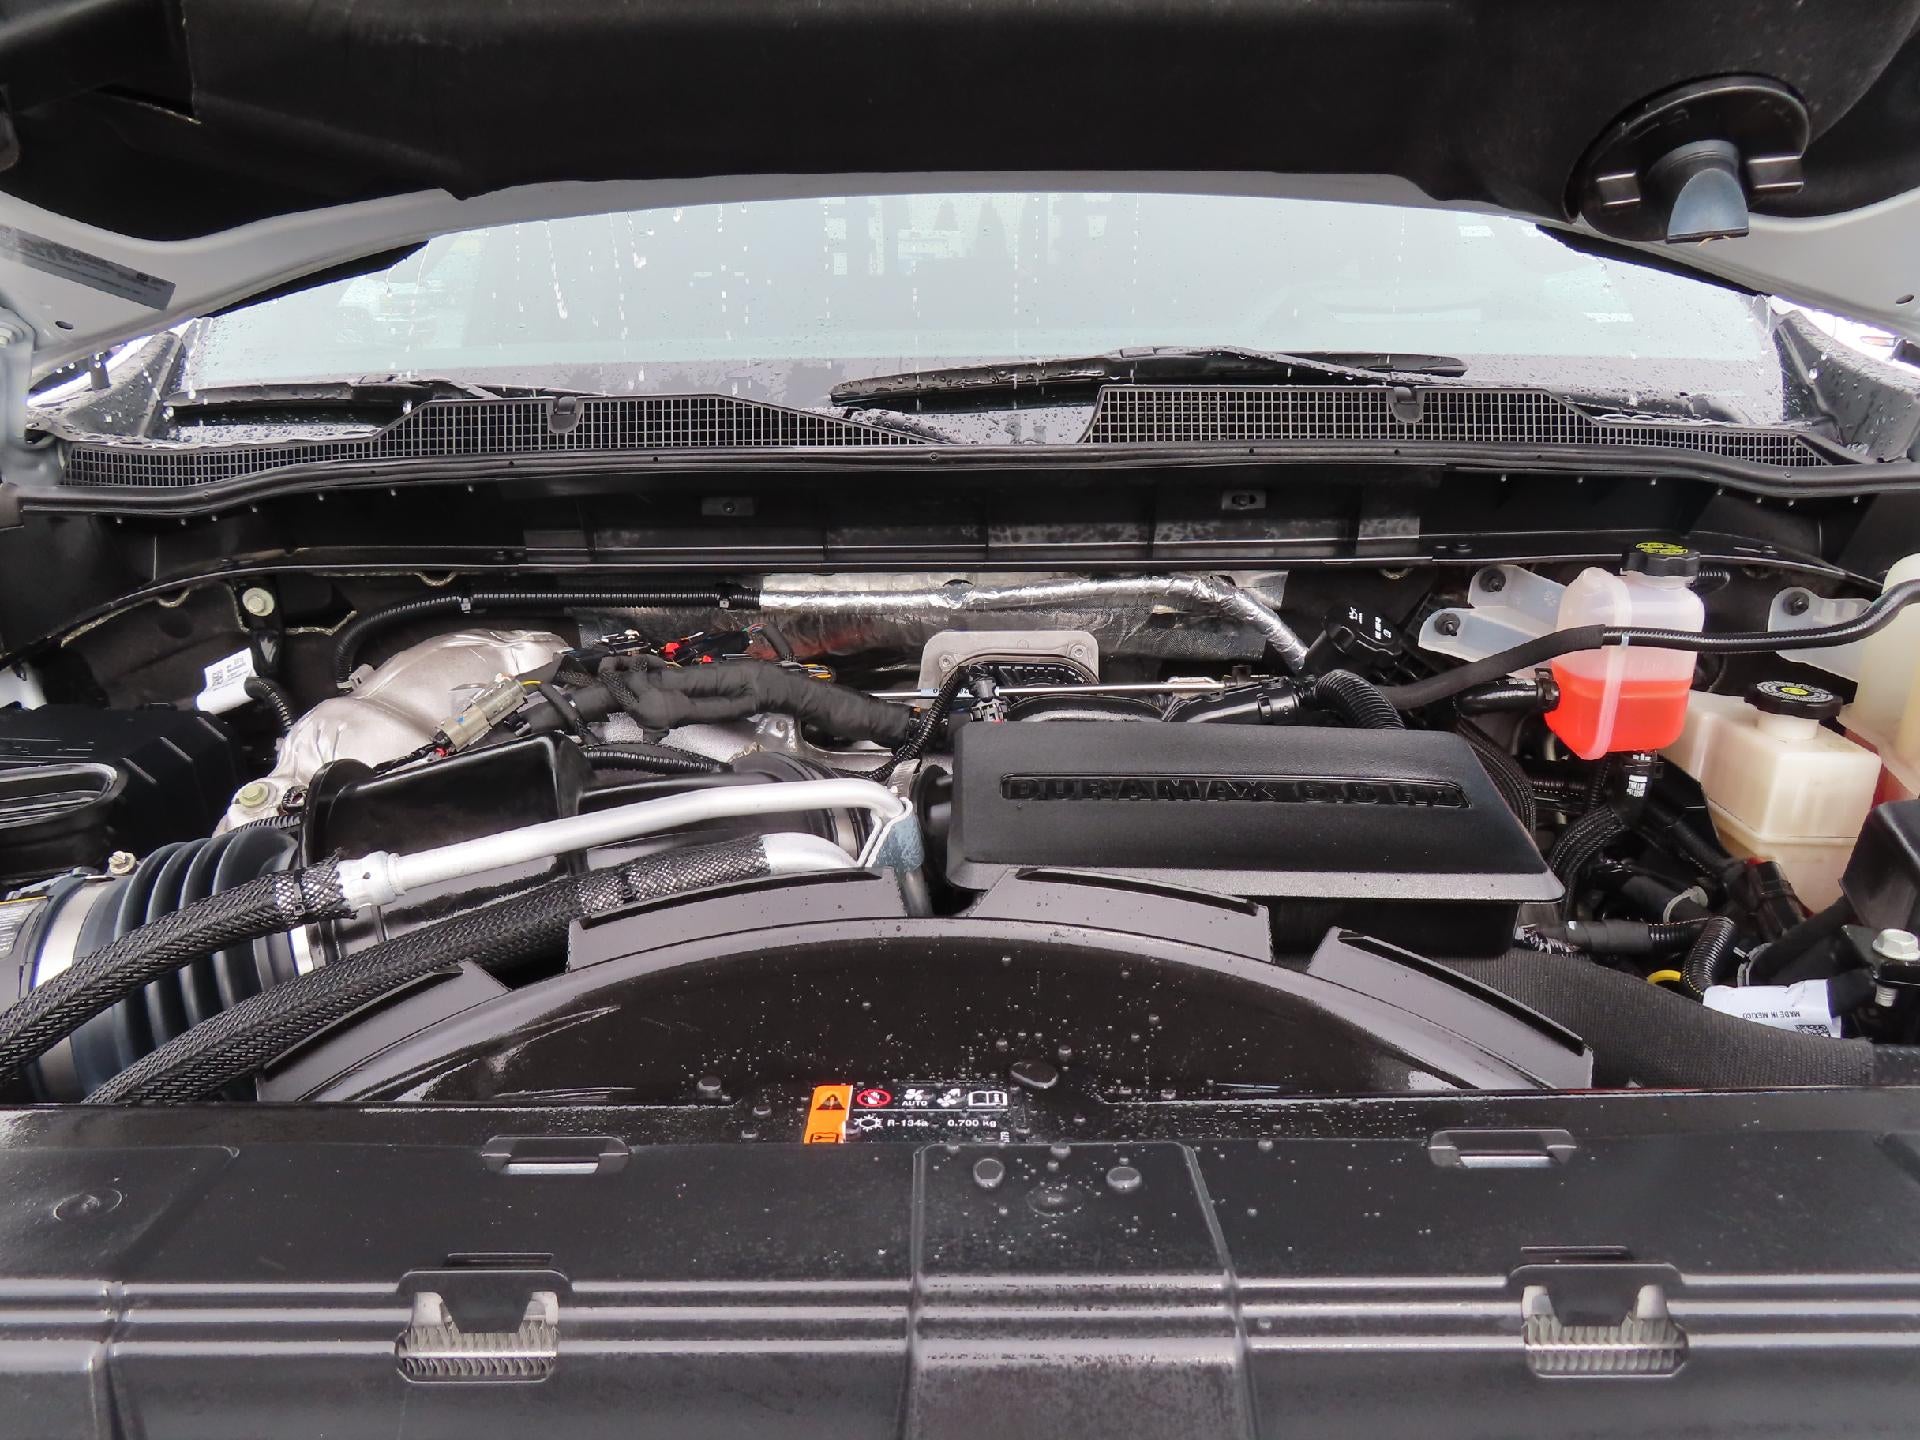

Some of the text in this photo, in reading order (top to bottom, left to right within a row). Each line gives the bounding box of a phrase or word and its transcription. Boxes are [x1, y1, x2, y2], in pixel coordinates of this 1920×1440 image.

[1002, 778, 1277, 802] DURAMAX
[1779, 1010, 1801, 1018] MADE
[886, 1119, 998, 1128] R-134a 0.700 kg
